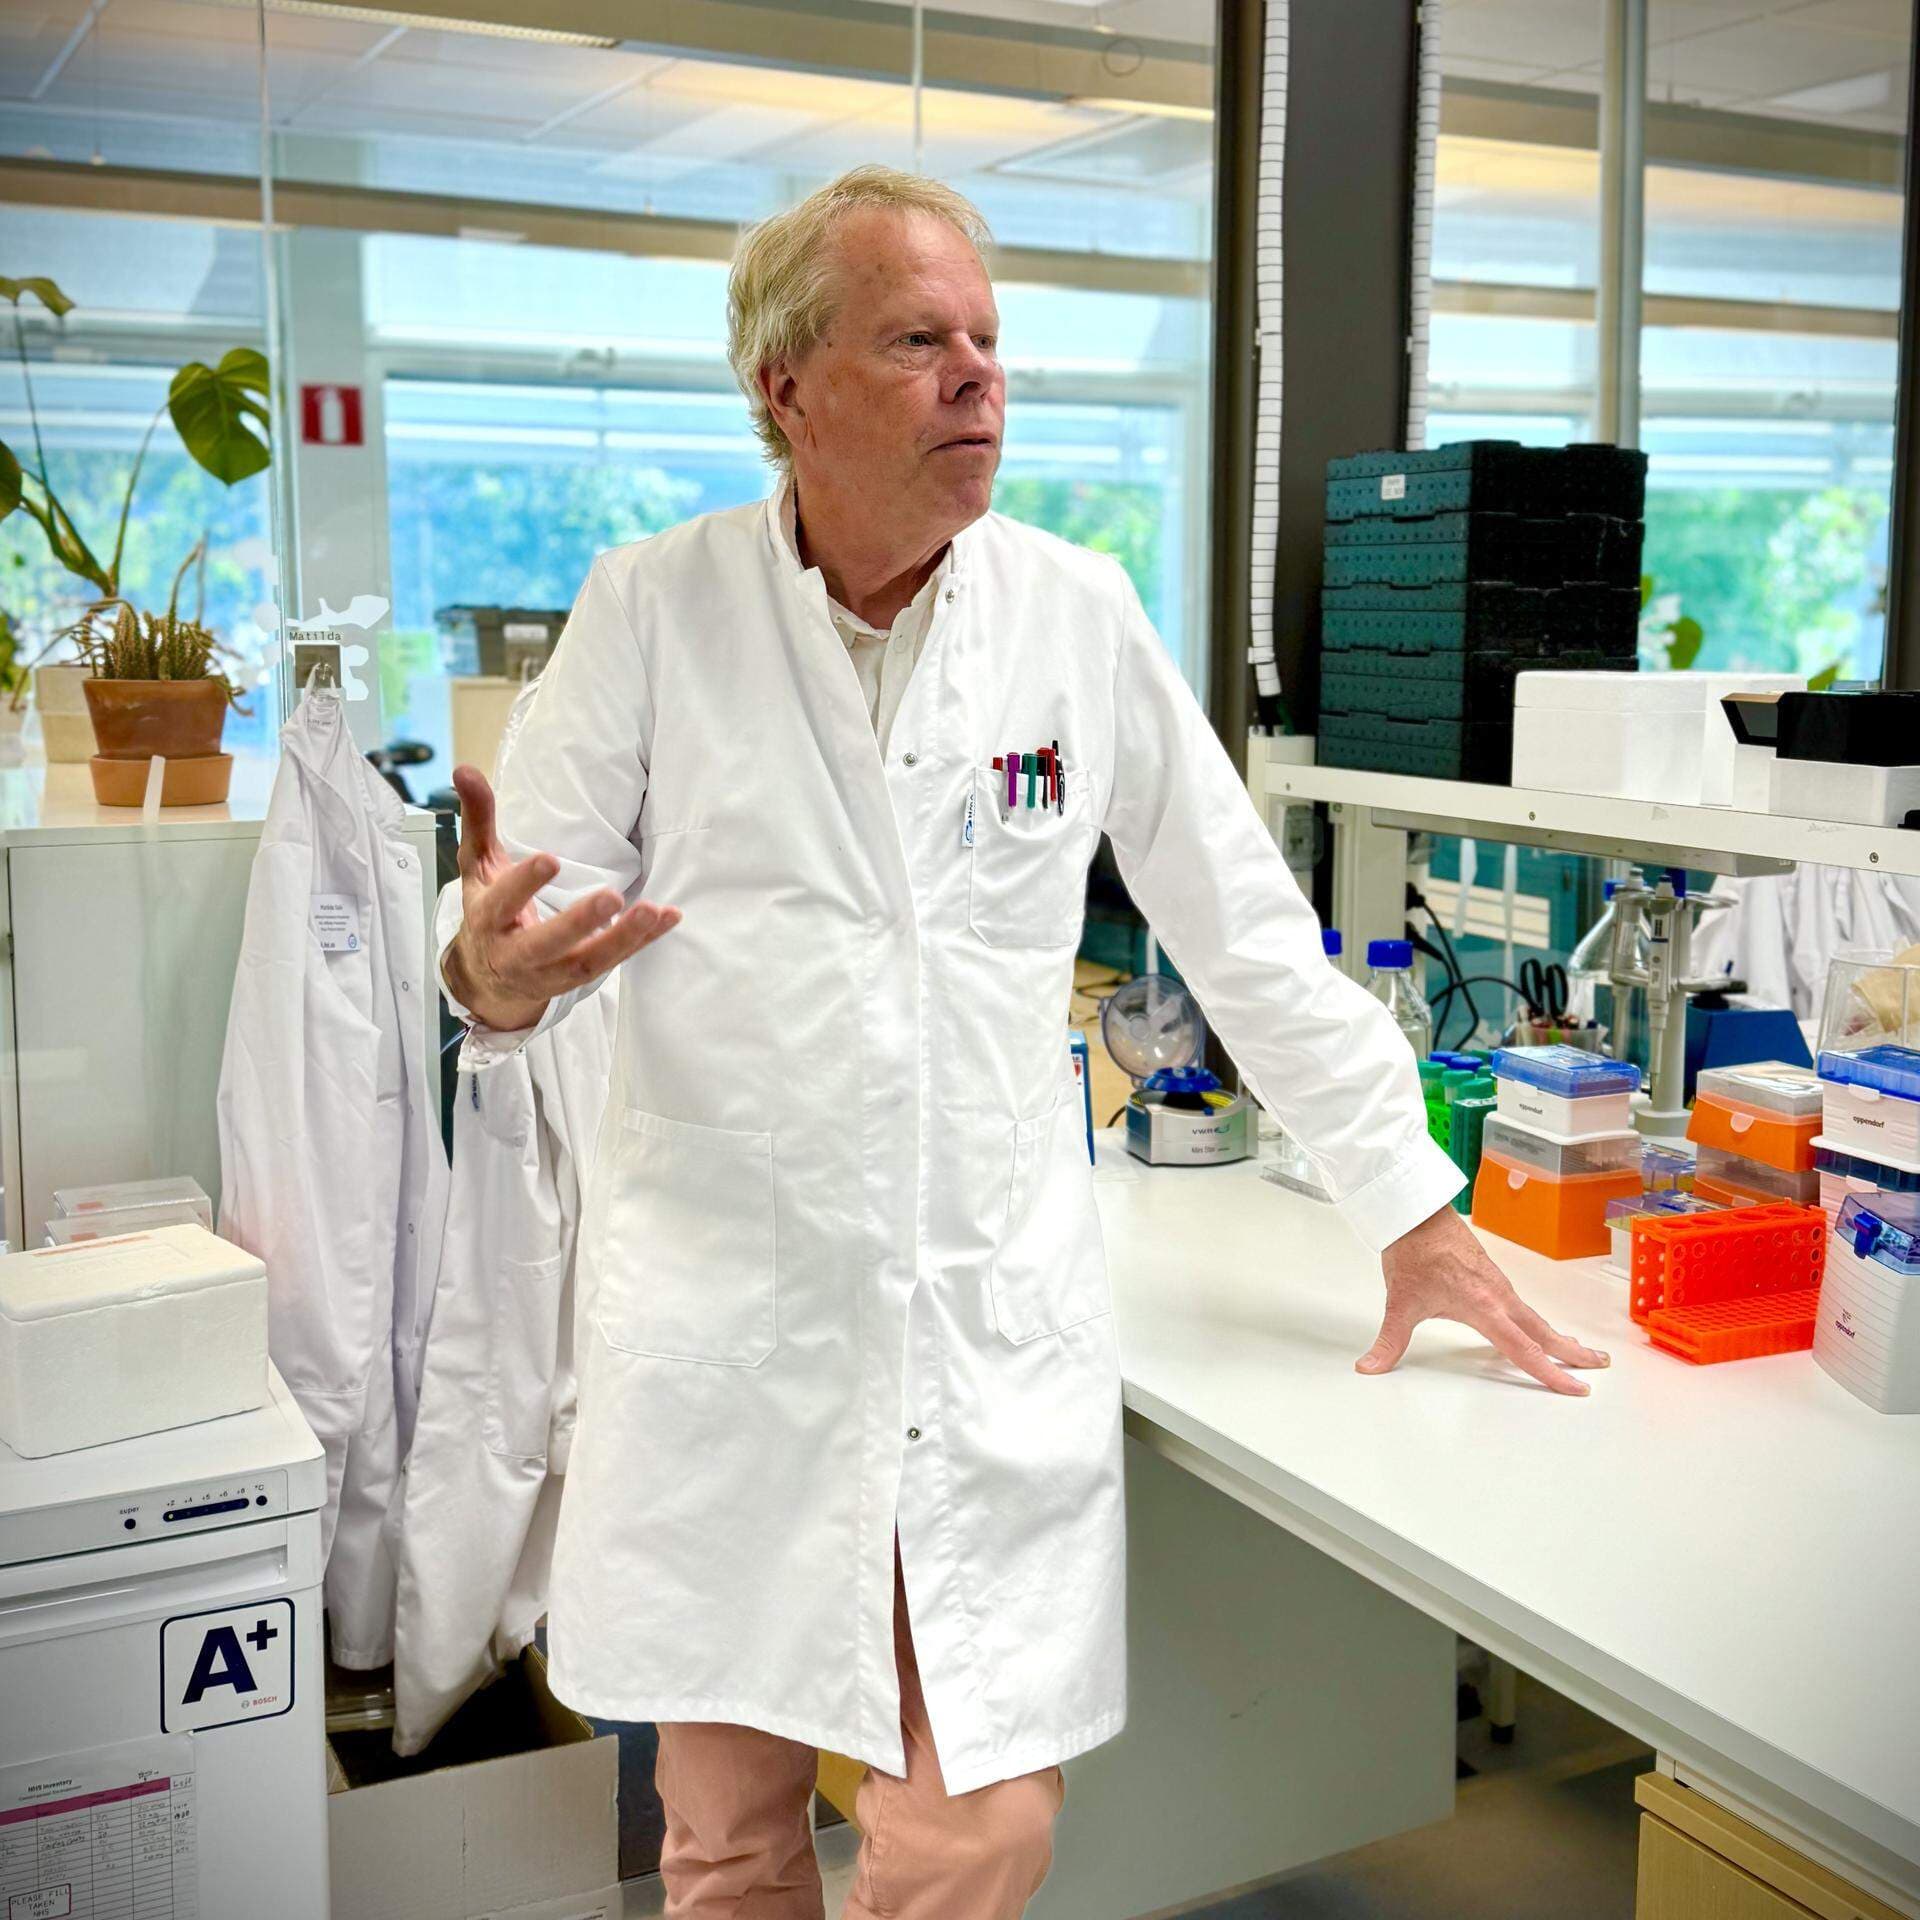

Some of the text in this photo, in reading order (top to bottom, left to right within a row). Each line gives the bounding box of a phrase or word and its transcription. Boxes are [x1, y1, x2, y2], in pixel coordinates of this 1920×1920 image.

[289, 631, 342, 641] Matilda
[1852, 1115, 1886, 1128] eppendorf
[119, 1506, 141, 1515] super
[252, 1696, 278, 1707] BOSCH
[11, 1892, 43, 1906] PLEASE
[28, 1900, 56, 1911] TAKEN
